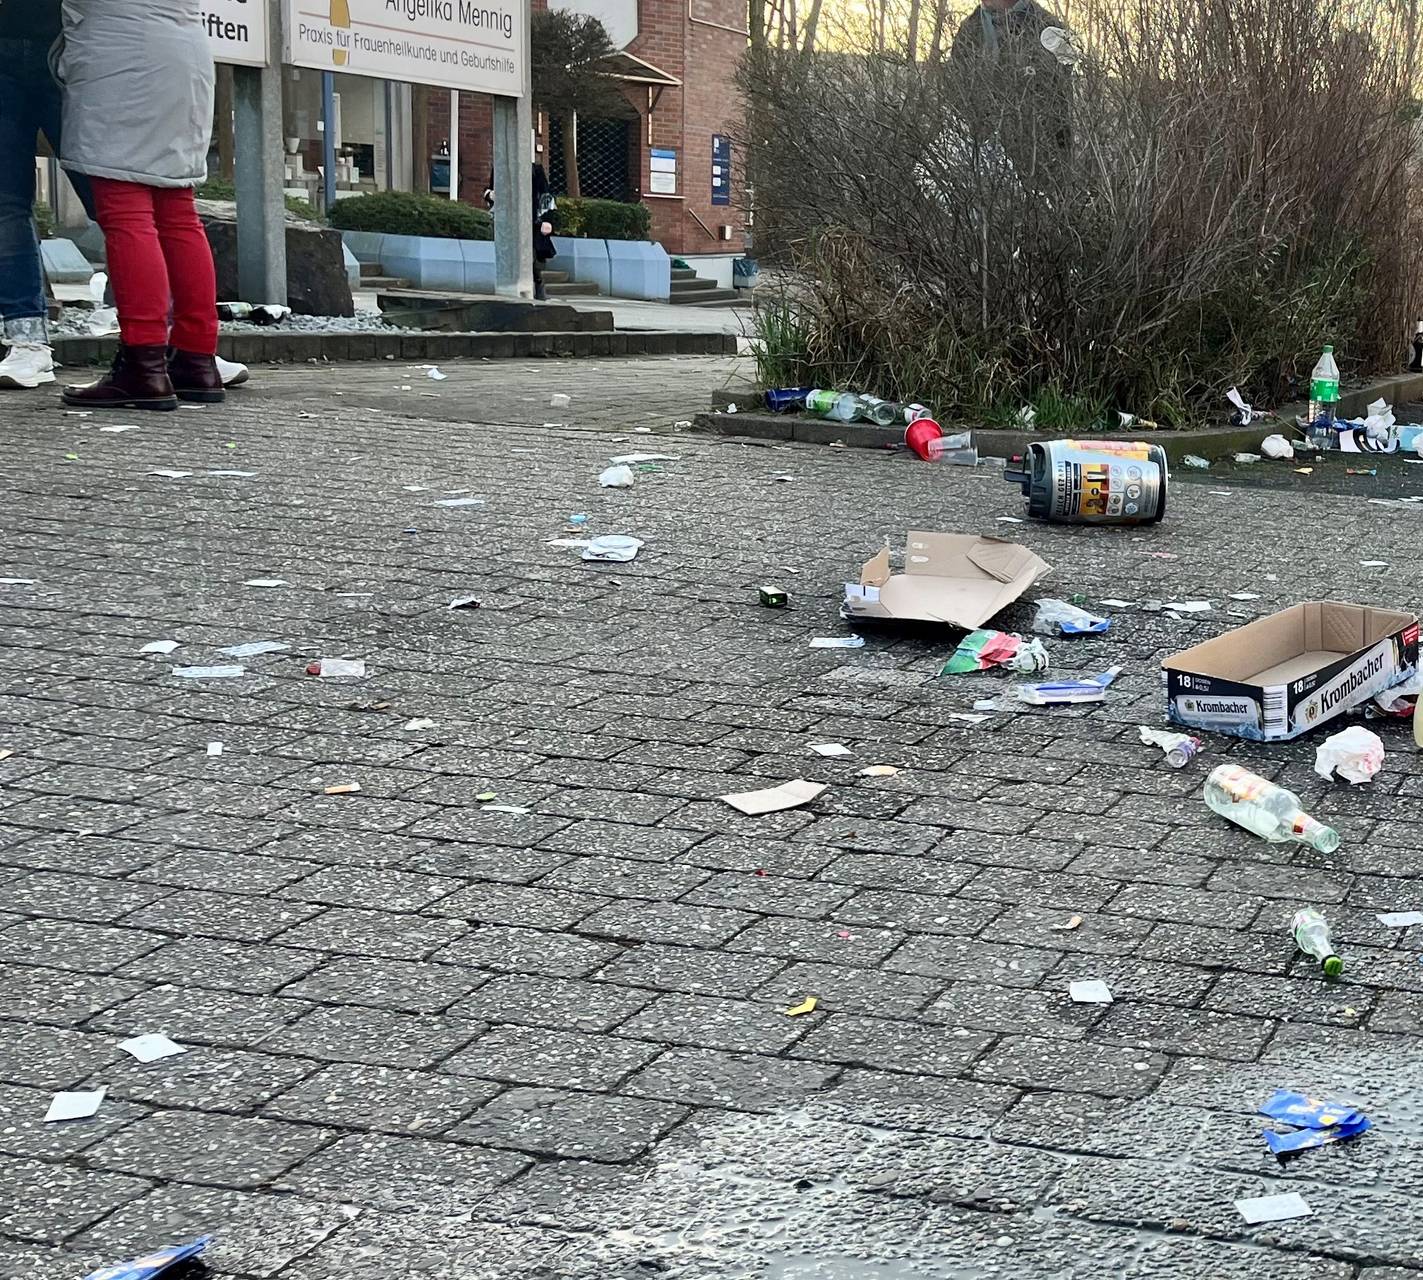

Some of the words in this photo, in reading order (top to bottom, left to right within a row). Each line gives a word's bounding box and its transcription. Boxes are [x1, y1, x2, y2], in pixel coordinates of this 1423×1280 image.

[201, 12, 248, 41] iften
[459, 1, 512, 38] Mennig
[299, 24, 333, 45] Praxis
[336, 28, 350, 47] für
[354, 32, 437, 62] Frauenheilkunde
[440, 50, 458, 65] und
[461, 51, 515, 74] Geburtshilfe
[1177, 674, 1191, 688] 18
[1293, 680, 1304, 695] 18
[1320, 652, 1384, 715] Krombacher
[1196, 700, 1248, 714] Krombacher
